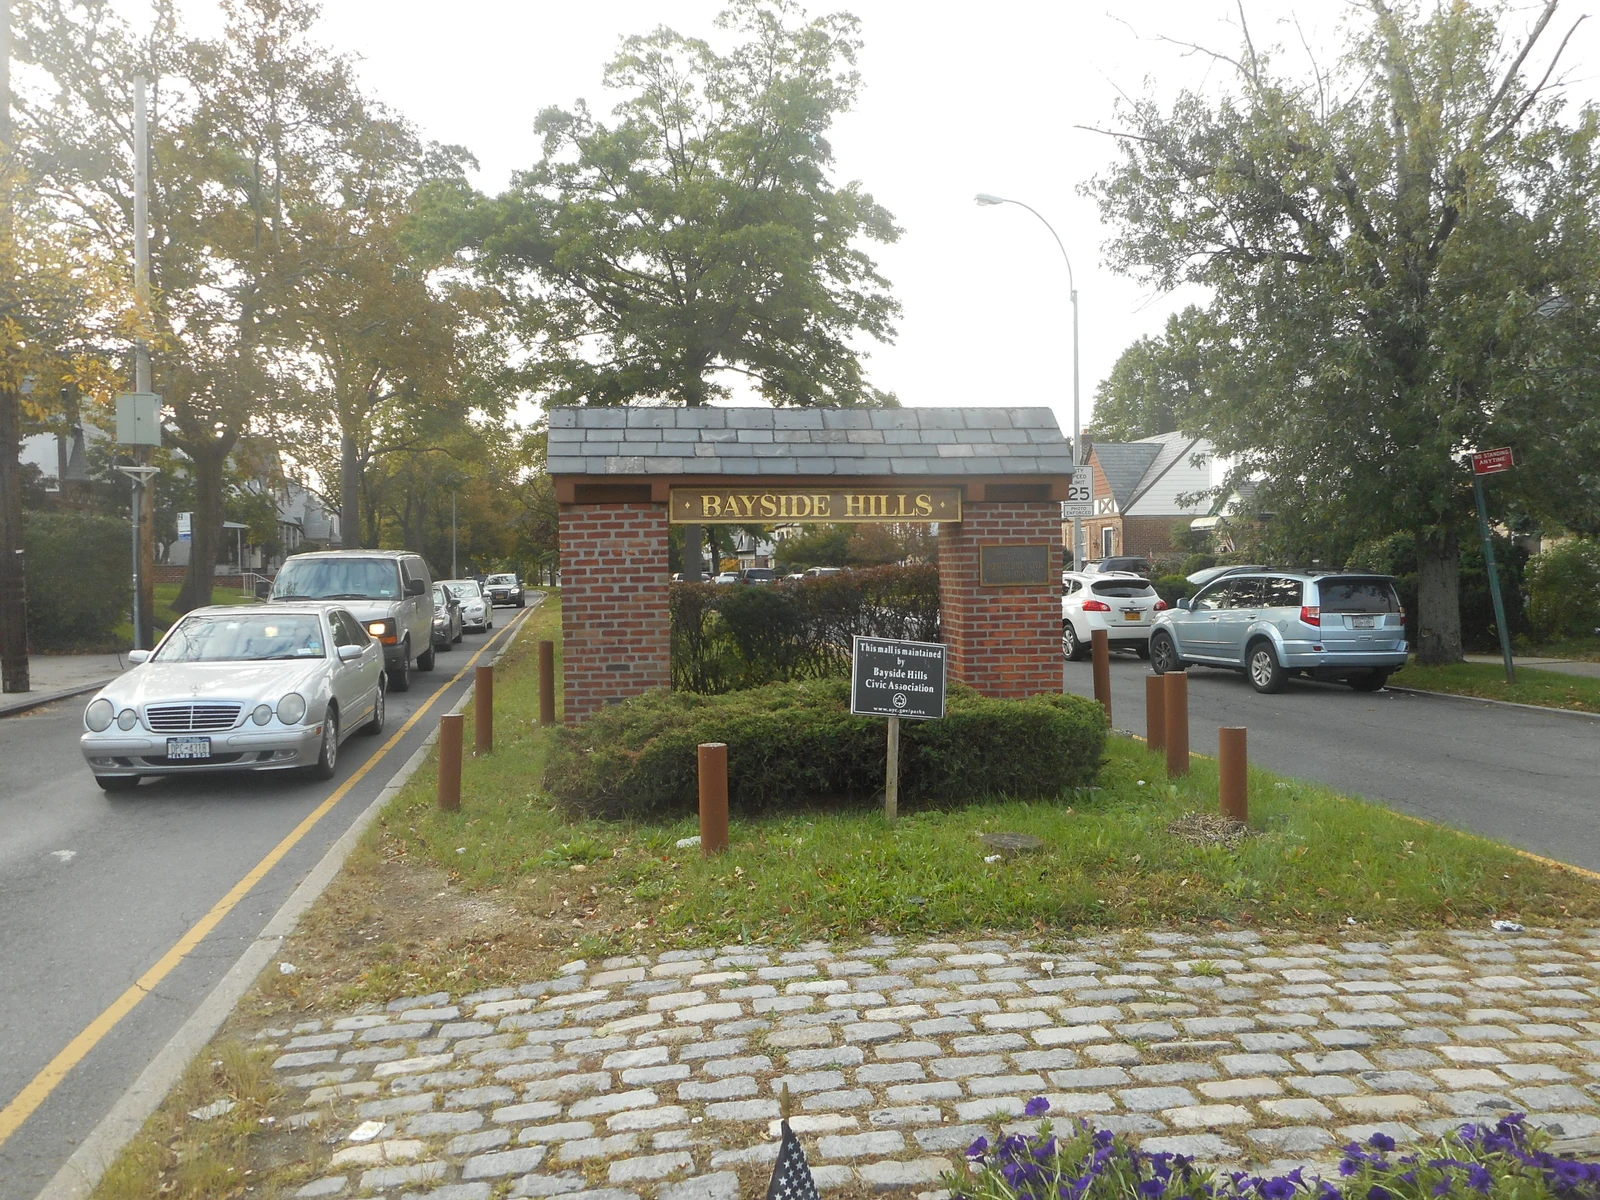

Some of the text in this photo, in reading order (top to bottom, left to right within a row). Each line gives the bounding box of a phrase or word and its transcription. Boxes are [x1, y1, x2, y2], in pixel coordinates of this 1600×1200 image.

[1479, 456, 1506, 465] ANYTIME
[1483, 450, 1509, 458] STANDING
[1068, 487, 1090, 501] 25
[700, 494, 933, 517] BAYSIDE HILLS
[860, 642, 941, 658] This mall is maintained
[897, 657, 905, 667] by
[873, 667, 928, 681] Bayside Hills
[865, 679, 934, 693] Civic Association
